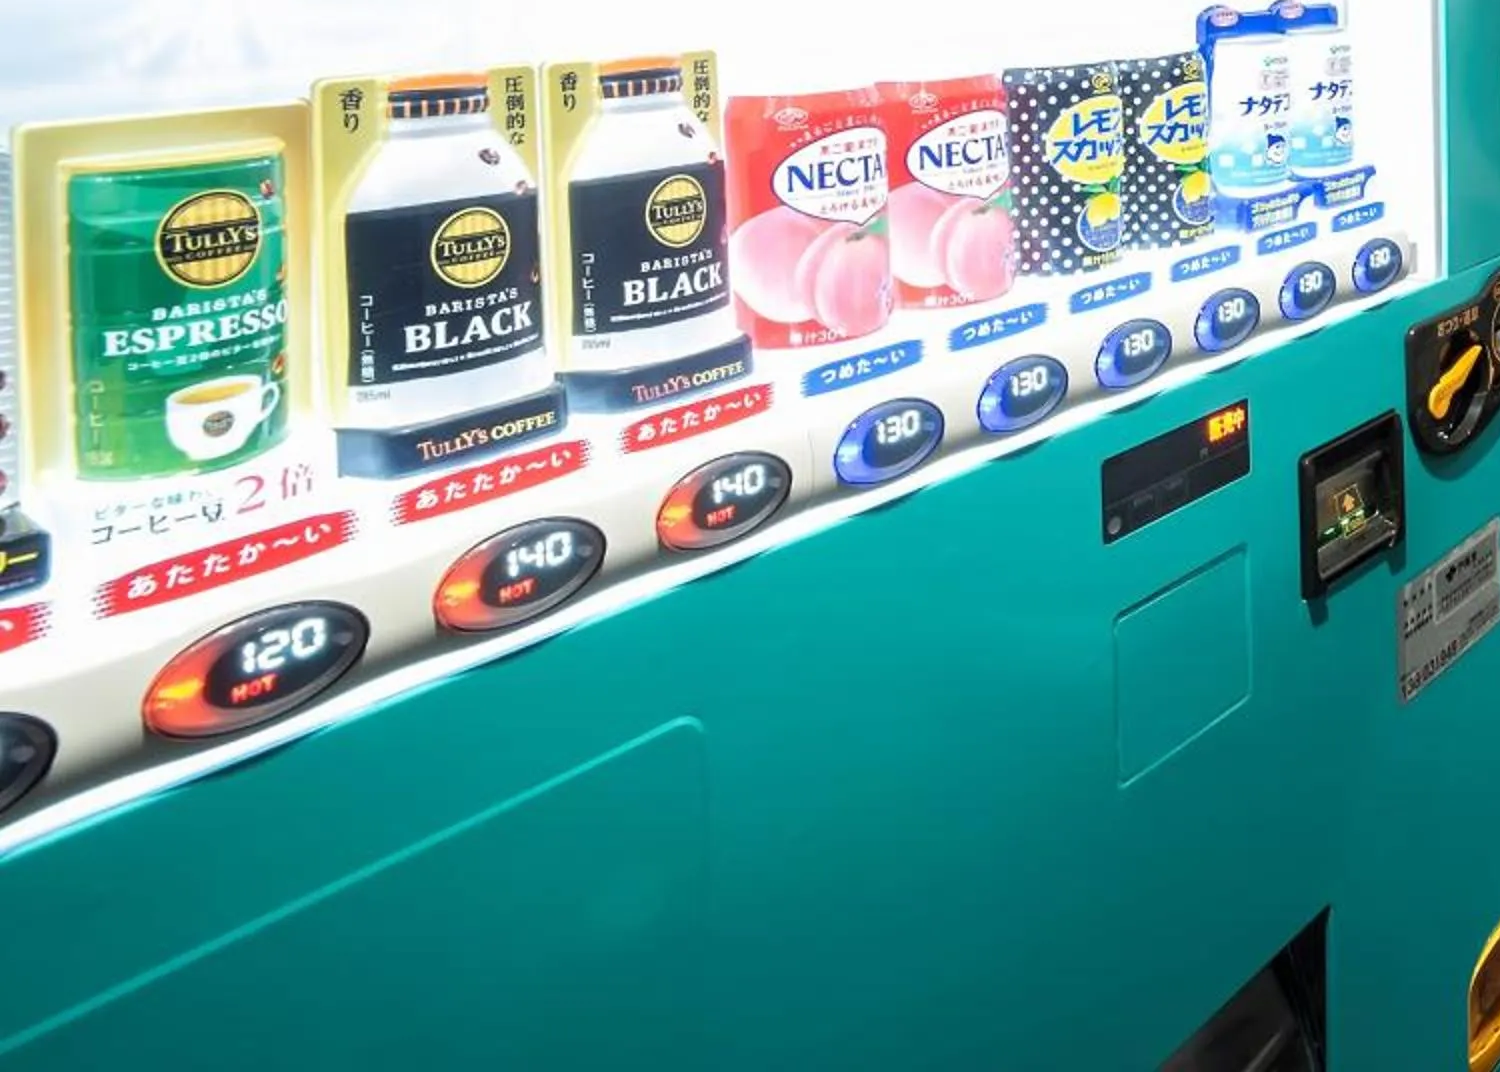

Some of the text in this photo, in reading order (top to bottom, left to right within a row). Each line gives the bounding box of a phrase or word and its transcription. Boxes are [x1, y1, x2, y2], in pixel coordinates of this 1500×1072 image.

[559, 70, 579, 113] 香り
[691, 58, 711, 124] 圧倒的な
[337, 86, 365, 135] 香り
[504, 75, 527, 147] 圧倒的な
[622, 262, 724, 308] BLACK
[1079, 275, 1142, 306] つめた～い
[1298, 270, 1323, 294] 130
[102, 298, 290, 358] ESPRESSO
[403, 300, 534, 355] BLACK
[963, 308, 1034, 342] つめた～い
[1217, 297, 1246, 321] 130
[1120, 332, 1154, 356] 130
[690, 360, 745, 386] COFFEE
[819, 347, 906, 383] つめた～い
[1009, 365, 1048, 395] 130
[489, 410, 557, 441] COFFEE
[636, 392, 764, 443] あたたか～い
[874, 412, 920, 445] 130
[414, 448, 574, 512] あたたか～い
[711, 464, 767, 504] 140
[705, 505, 736, 529] HOT
[126, 521, 333, 599] あたたか～い
[506, 531, 573, 578] 140
[499, 579, 537, 605] HOT
[241, 618, 326, 675] 120
[229, 674, 280, 705] HOT
